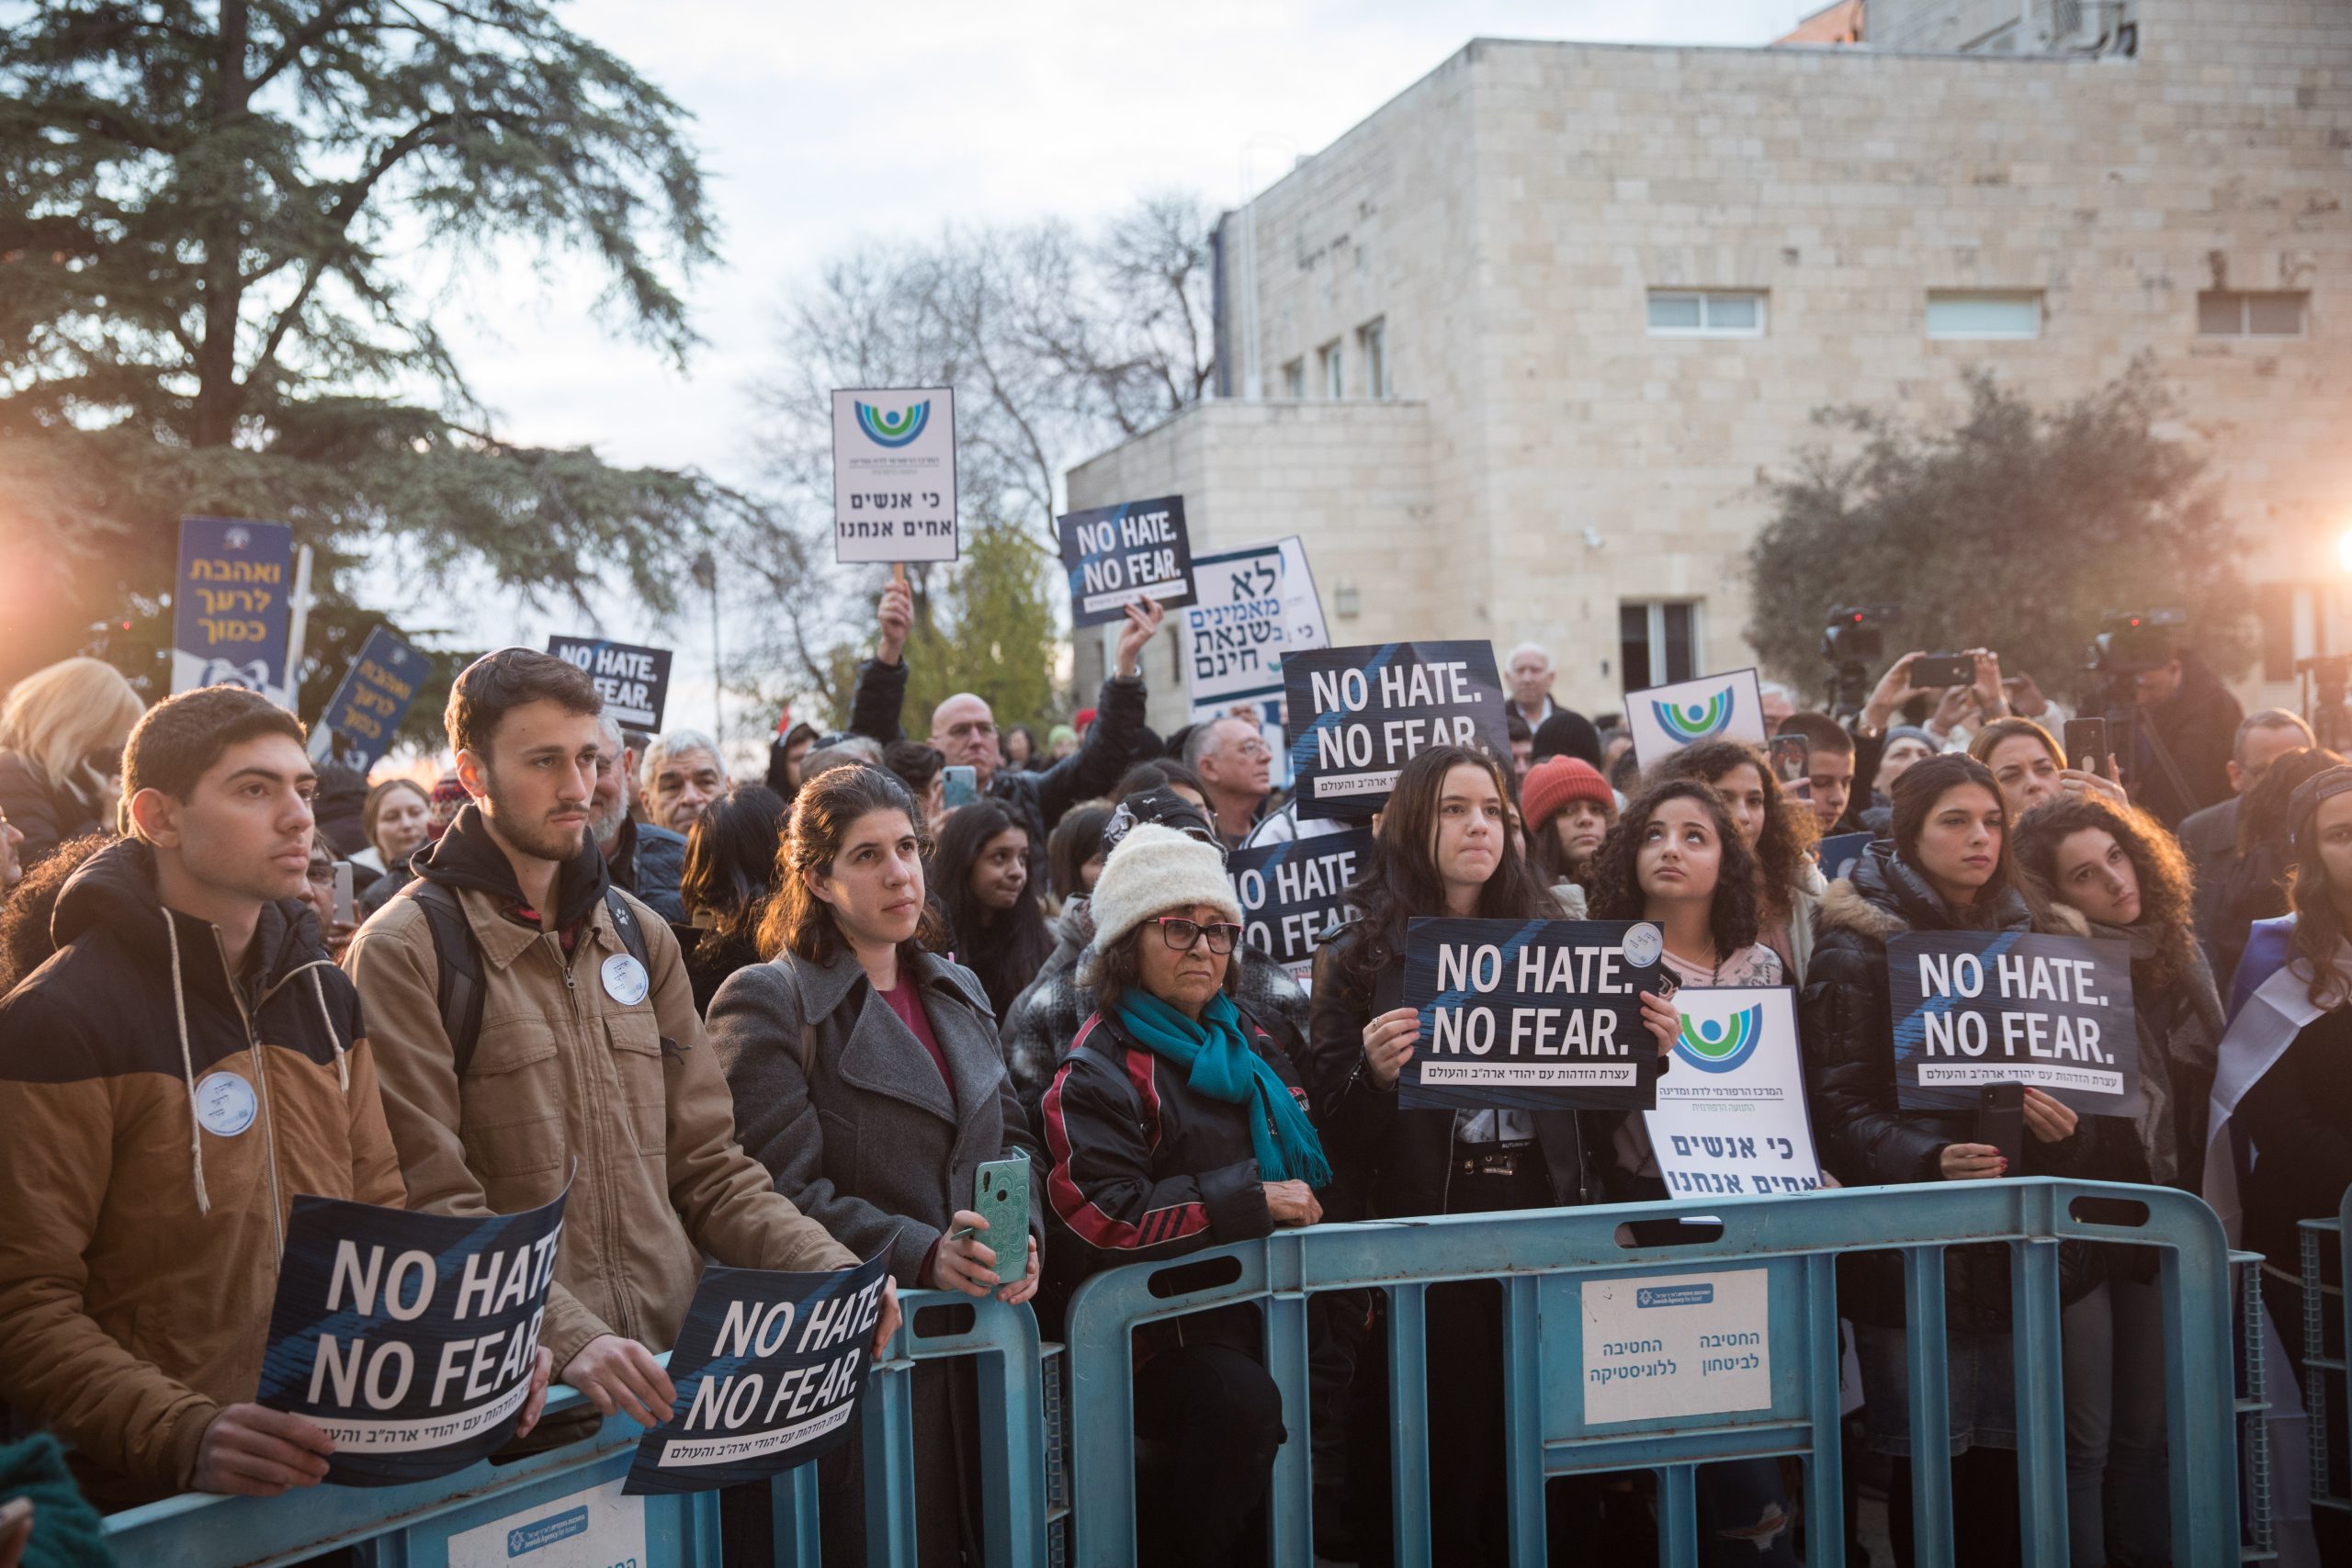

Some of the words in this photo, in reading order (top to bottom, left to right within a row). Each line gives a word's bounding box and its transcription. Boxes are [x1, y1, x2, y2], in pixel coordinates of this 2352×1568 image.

[850, 491, 912, 510] אנשים
[921, 491, 941, 509] כי
[839, 521, 894, 538] אנחנו
[903, 520, 953, 537] אחים
[1075, 521, 1117, 558] NO
[1118, 510, 1178, 548] HATE.
[187, 558, 281, 584] ואהבת
[1082, 558, 1123, 594] NO
[1125, 547, 1182, 586] FEAR.
[1231, 559, 1276, 602] לא
[195, 588, 272, 616] לרעך
[1189, 597, 1281, 629] מאמינים
[196, 617, 267, 646] כמוך
[1194, 620, 1283, 655] בשנאת
[1297, 625, 1314, 638] כי
[558, 644, 593, 671] NO
[594, 648, 658, 682] HATE.
[1195, 649, 1260, 680] חינם
[1311, 668, 1369, 715] NO
[1379, 661, 1482, 709] HATE.
[1317, 723, 1373, 770] NO
[1320, 780, 1355, 792] והעולם
[1437, 943, 1502, 994] NO
[1516, 945, 1634, 994] HATE.
[1918, 953, 1984, 998] NO
[1996, 953, 2109, 1007] HATE.
[1431, 1007, 1496, 1055] NO
[1510, 1008, 1629, 1055] FEAR.
[1924, 1010, 1988, 1056] NO
[2001, 1011, 2114, 1064] FEAR.
[1428, 1066, 1468, 1078] והעולם
[1509, 1068, 1535, 1079] יהודי
[1539, 1069, 1555, 1079] עם
[1557, 1068, 1597, 1079] הזדהות
[1599, 1068, 1630, 1079] עצרת
[1926, 1067, 1966, 1080] והעולם
[2007, 1069, 2036, 1079] יהודי
[2038, 1070, 2053, 1080] עם
[2054, 1072, 2090, 1085] הזדהות
[2091, 1075, 2118, 1088] עצרת
[1658, 1087, 1690, 1096] ומדינה
[1690, 1086, 1711, 1096] לדת
[1712, 1087, 1752, 1097] הרפורמי
[1752, 1087, 1783, 1097] המרכז
[1669, 1134, 1758, 1159] אנשים
[1765, 1136, 1794, 1160] כי
[1667, 1170, 1745, 1194] אנחנו
[1750, 1174, 1817, 1194] אחים
[325, 1238, 437, 1321] NO
[452, 1219, 564, 1321] HATE
[710, 1300, 796, 1359] NO
[796, 1272, 885, 1354] HATE.
[1603, 1339, 1663, 1356] החטיבה
[1700, 1332, 1760, 1348] החטיבה
[306, 1332, 414, 1410] NO
[429, 1305, 544, 1408] FEAR
[1702, 1353, 1759, 1377] לביטחון
[1589, 1359, 1677, 1385] ללוגיסטיקה
[684, 1373, 764, 1431] NO
[763, 1348, 861, 1424] FEAR.
[462, 1416, 482, 1432] עם
[825, 1407, 849, 1425] עצרת
[320, 1427, 360, 1443] והע
[423, 1421, 460, 1439] יהודי
[780, 1430, 796, 1445] עם
[795, 1418, 828, 1439] הזדהות
[670, 1444, 716, 1460] והעולם
[753, 1437, 780, 1451] יהודי
